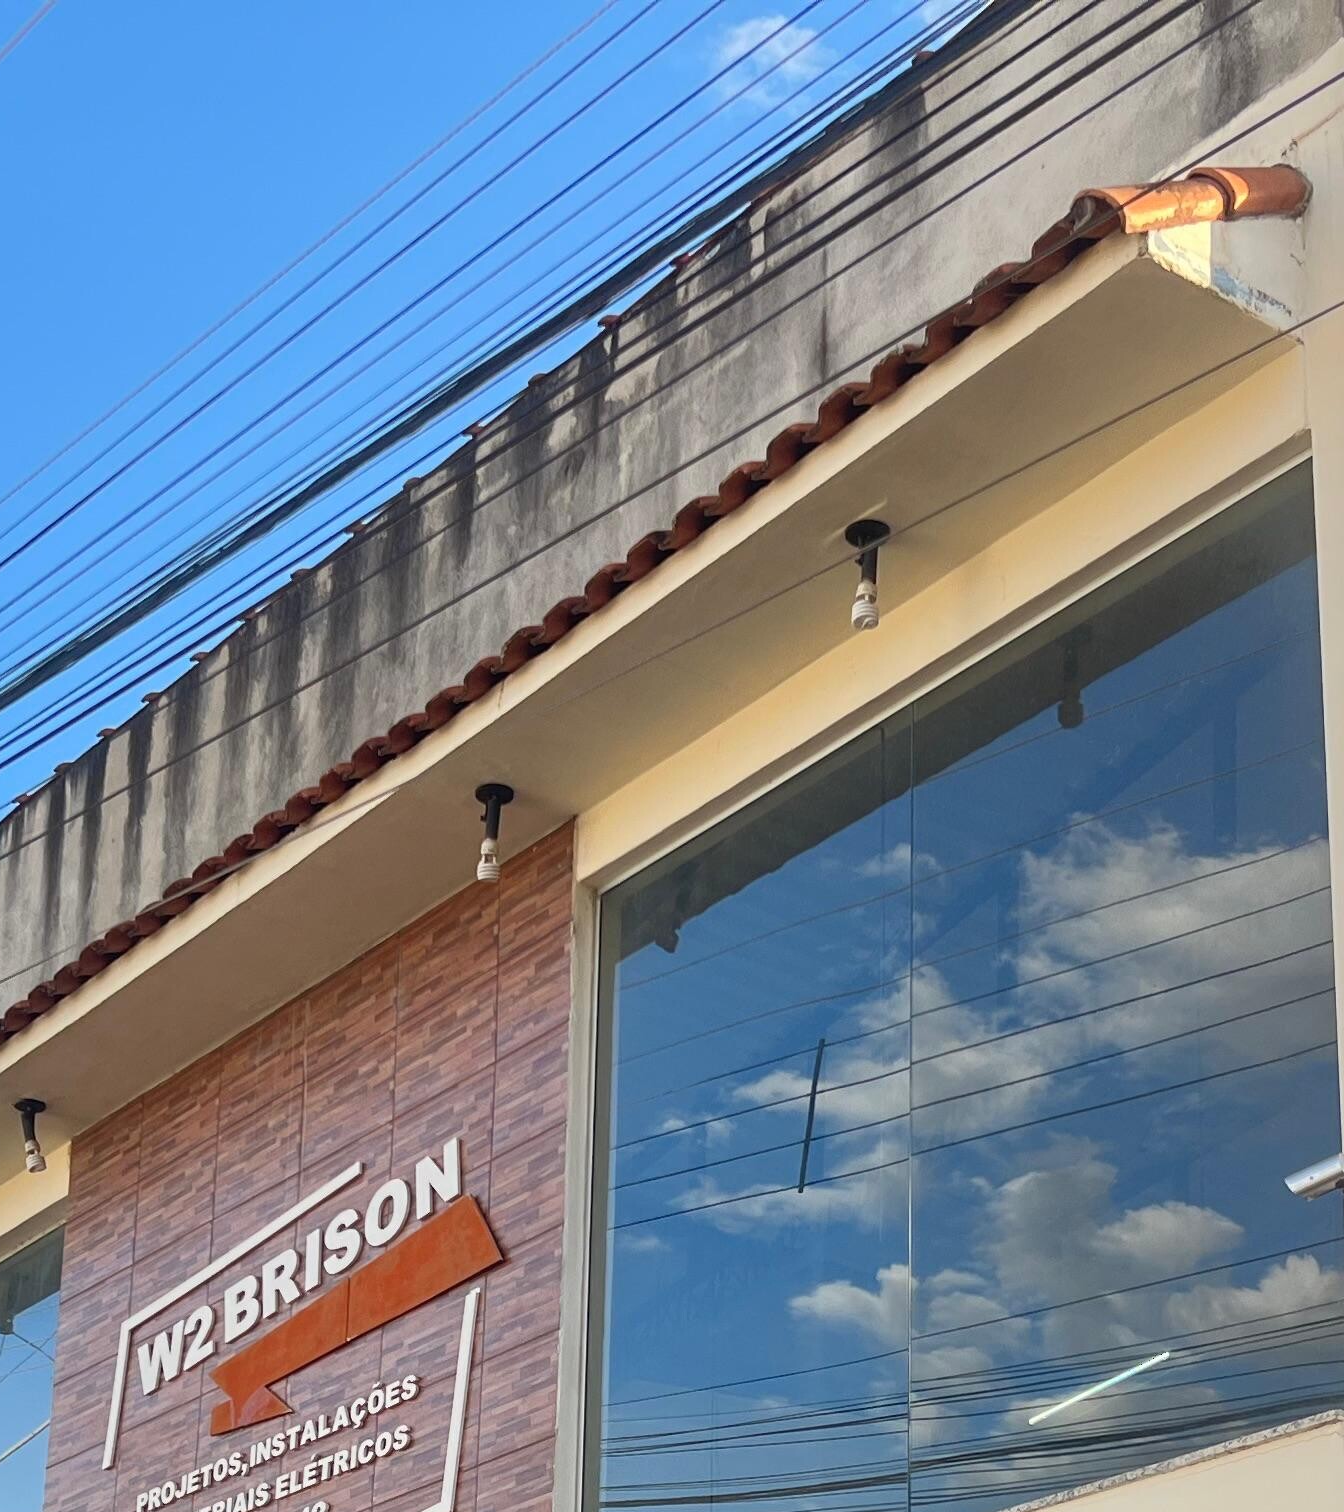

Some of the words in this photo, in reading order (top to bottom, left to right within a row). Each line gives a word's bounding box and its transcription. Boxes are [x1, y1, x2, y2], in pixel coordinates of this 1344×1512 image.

[137, 1304, 217, 1397] W2
[223, 1137, 461, 1345] BRISON
[275, 1424, 414, 1500] ELÉTRICOS
